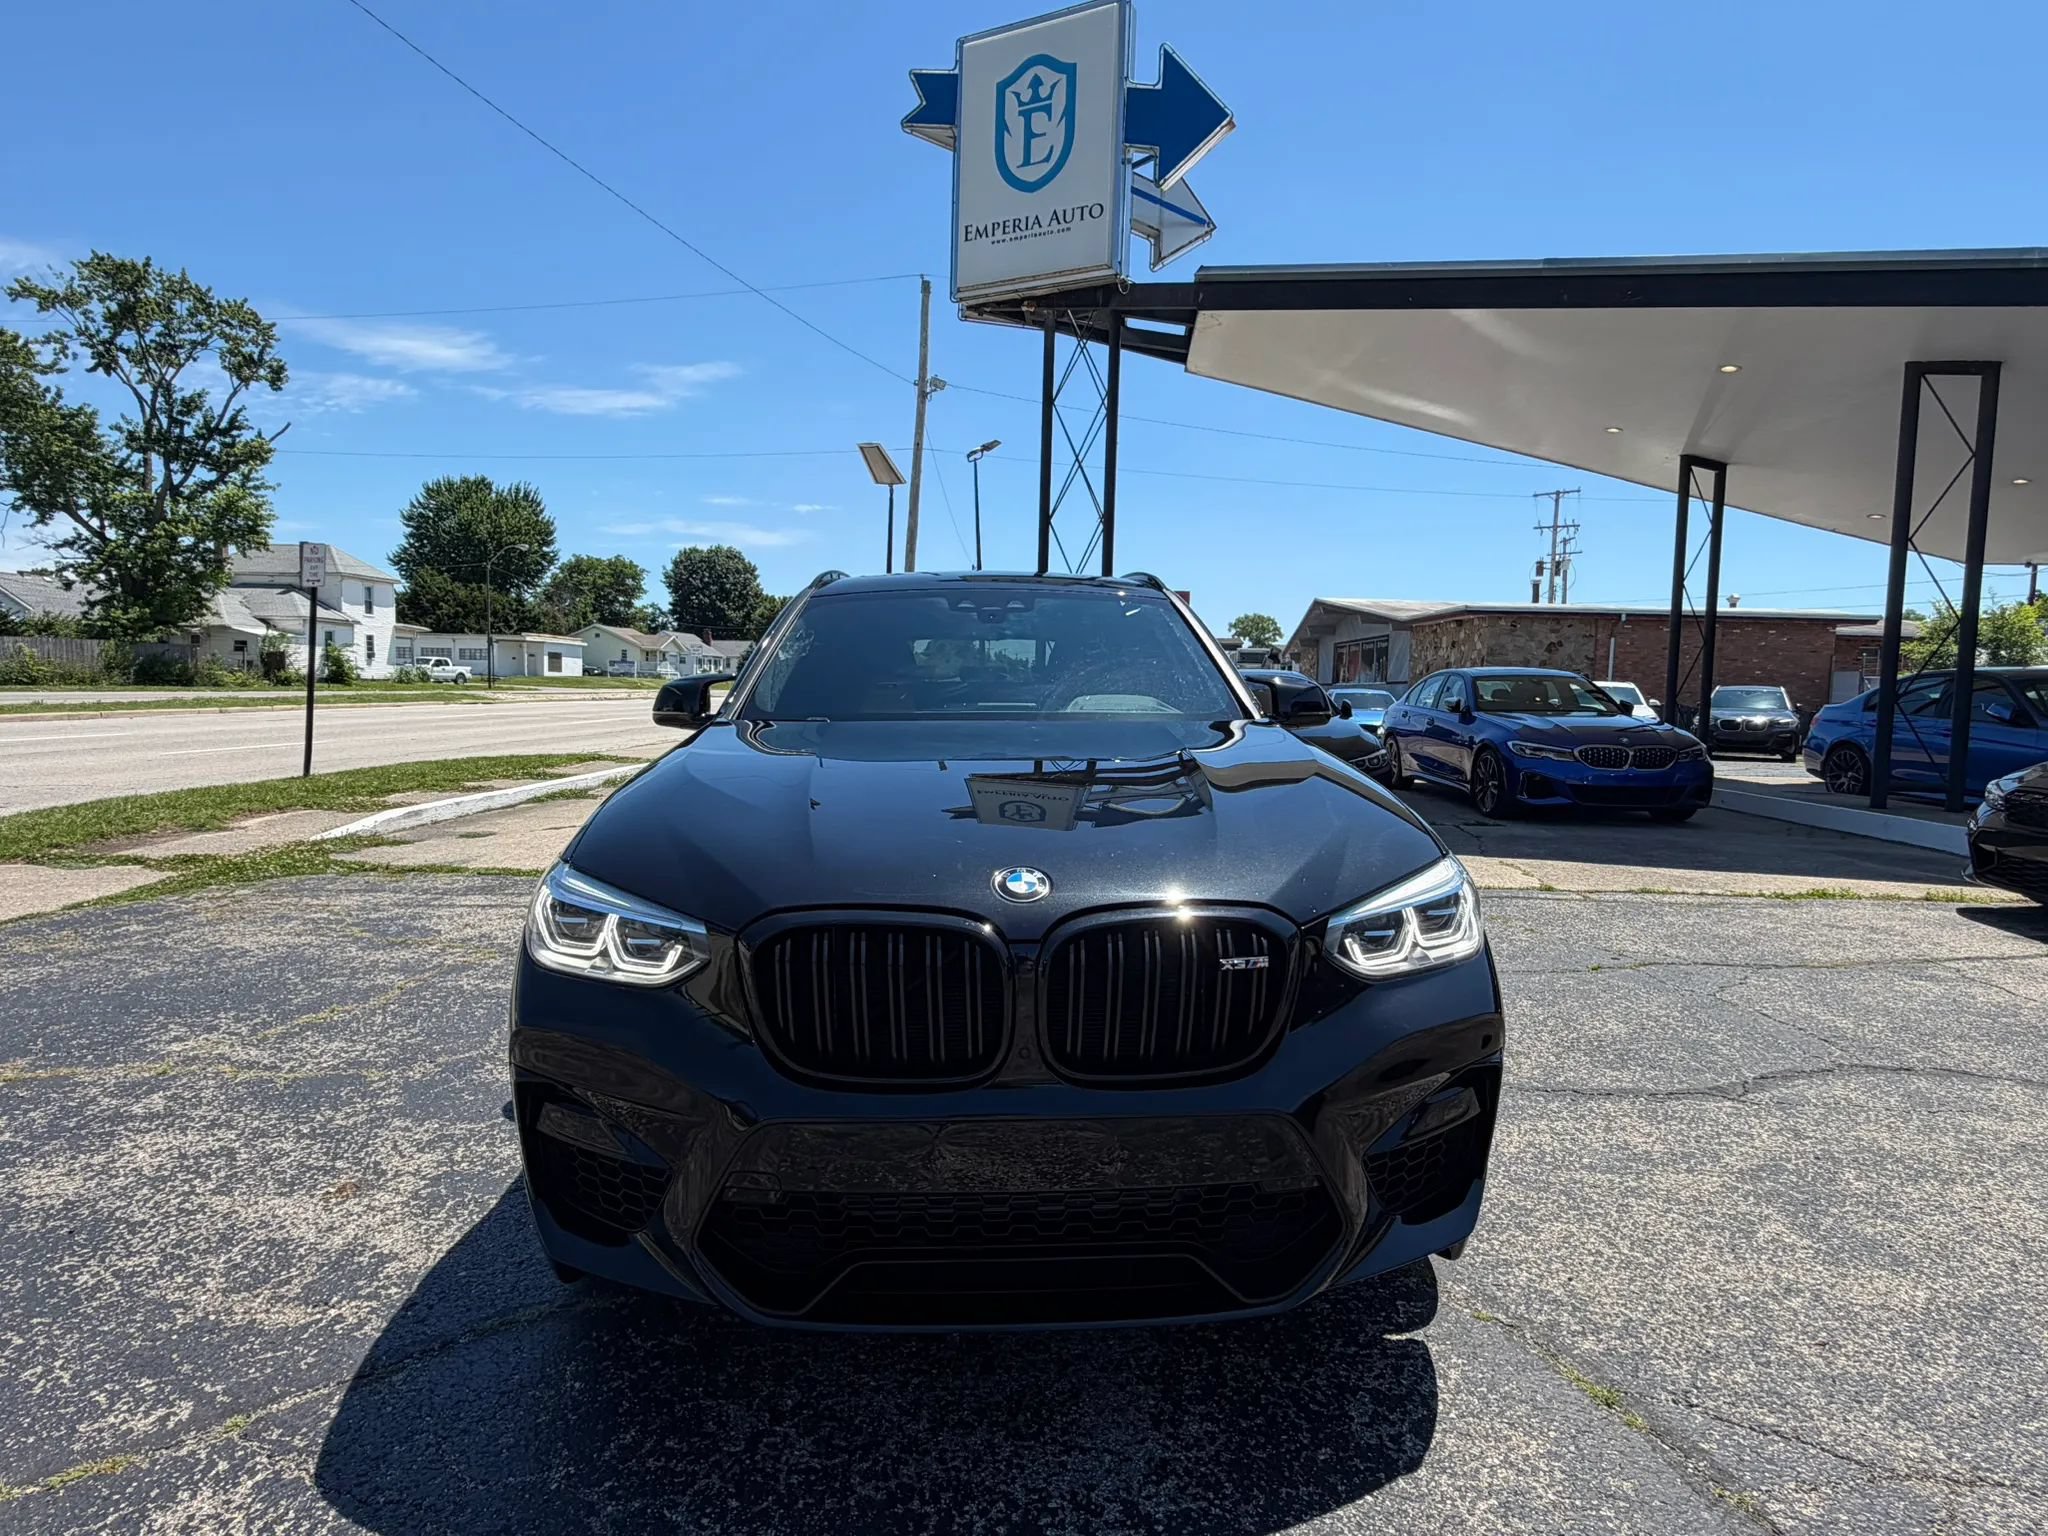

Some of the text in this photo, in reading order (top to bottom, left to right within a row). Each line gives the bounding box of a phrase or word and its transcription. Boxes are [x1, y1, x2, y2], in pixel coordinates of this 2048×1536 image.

[1016, 104, 1053, 168] E
[963, 203, 1105, 242] EMPERIA AUTO
